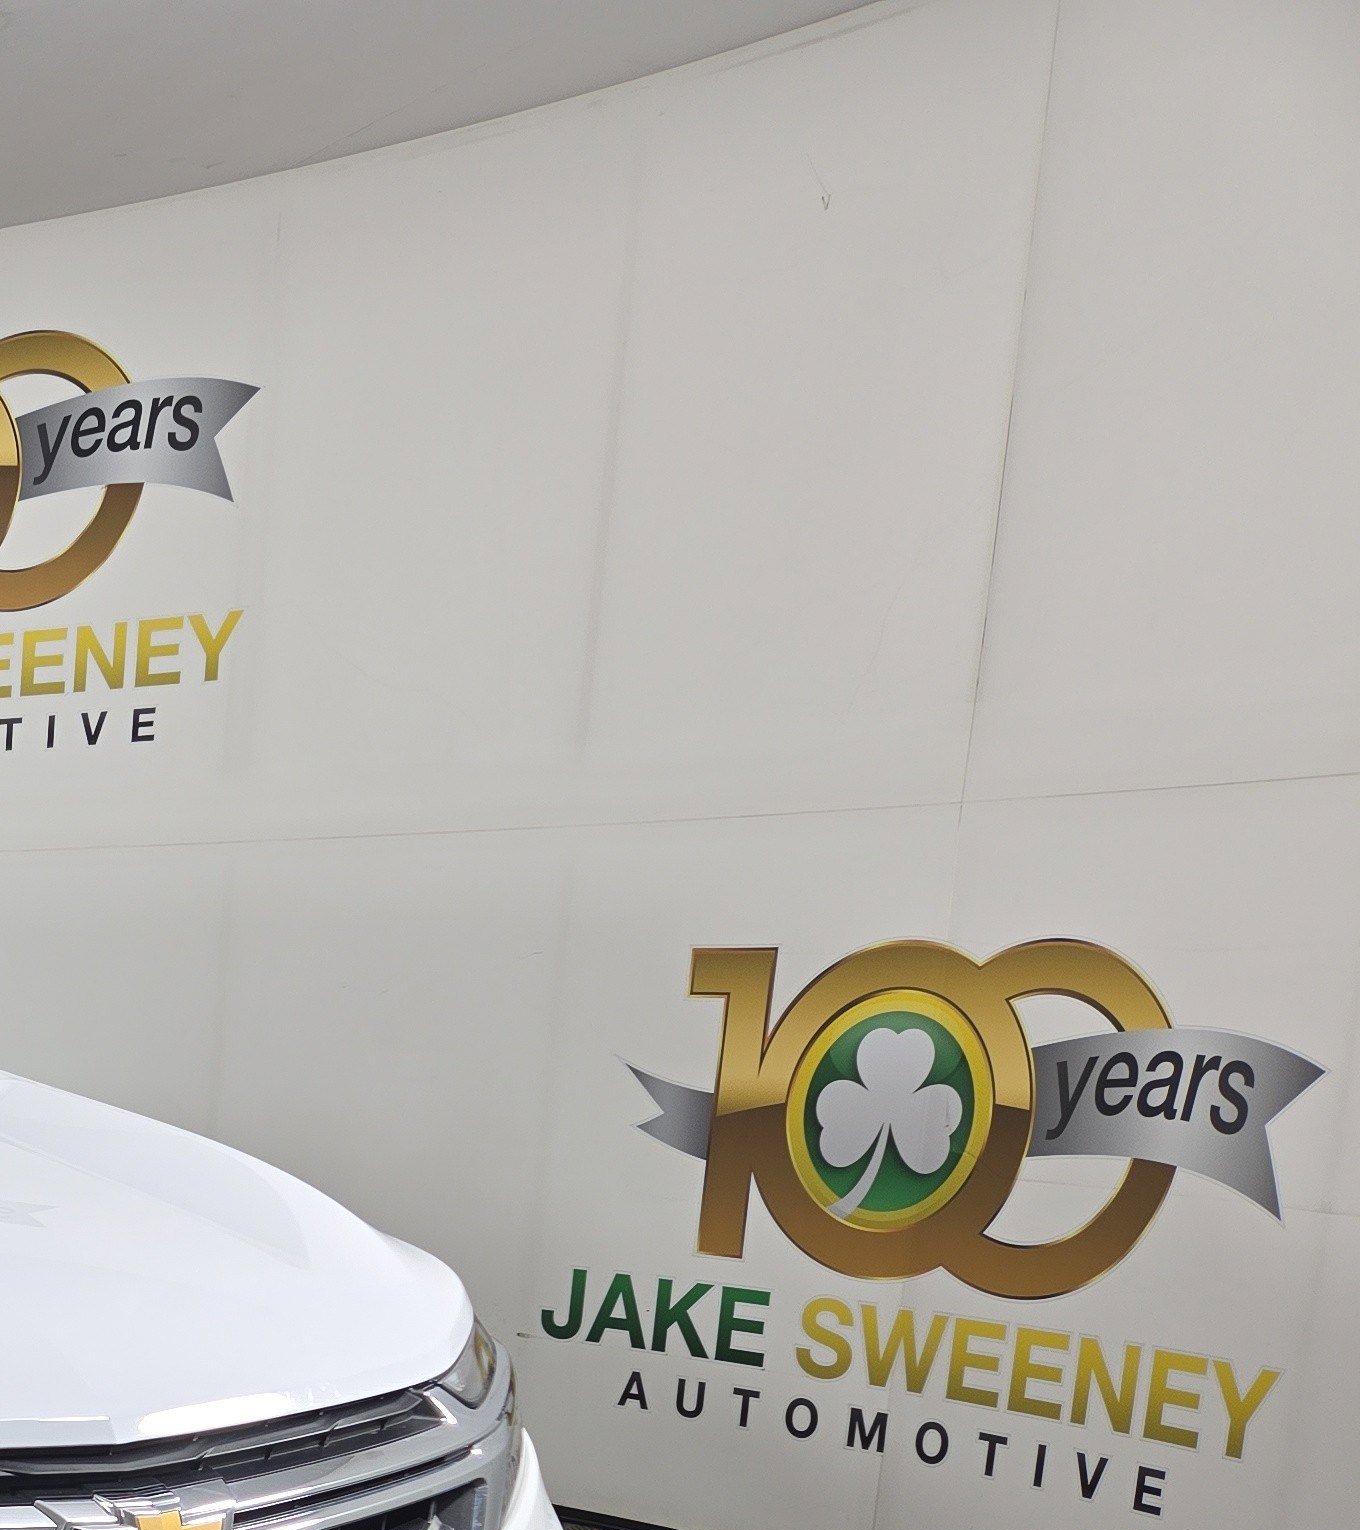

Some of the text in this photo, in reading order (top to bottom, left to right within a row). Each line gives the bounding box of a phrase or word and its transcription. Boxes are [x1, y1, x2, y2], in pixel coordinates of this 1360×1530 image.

[33, 394, 204, 485] years
[1045, 1048, 1257, 1142] years
[540, 1267, 1282, 1461] JAKE SWEENEY
[619, 1371, 1167, 1516] AUTOMOTIVE
